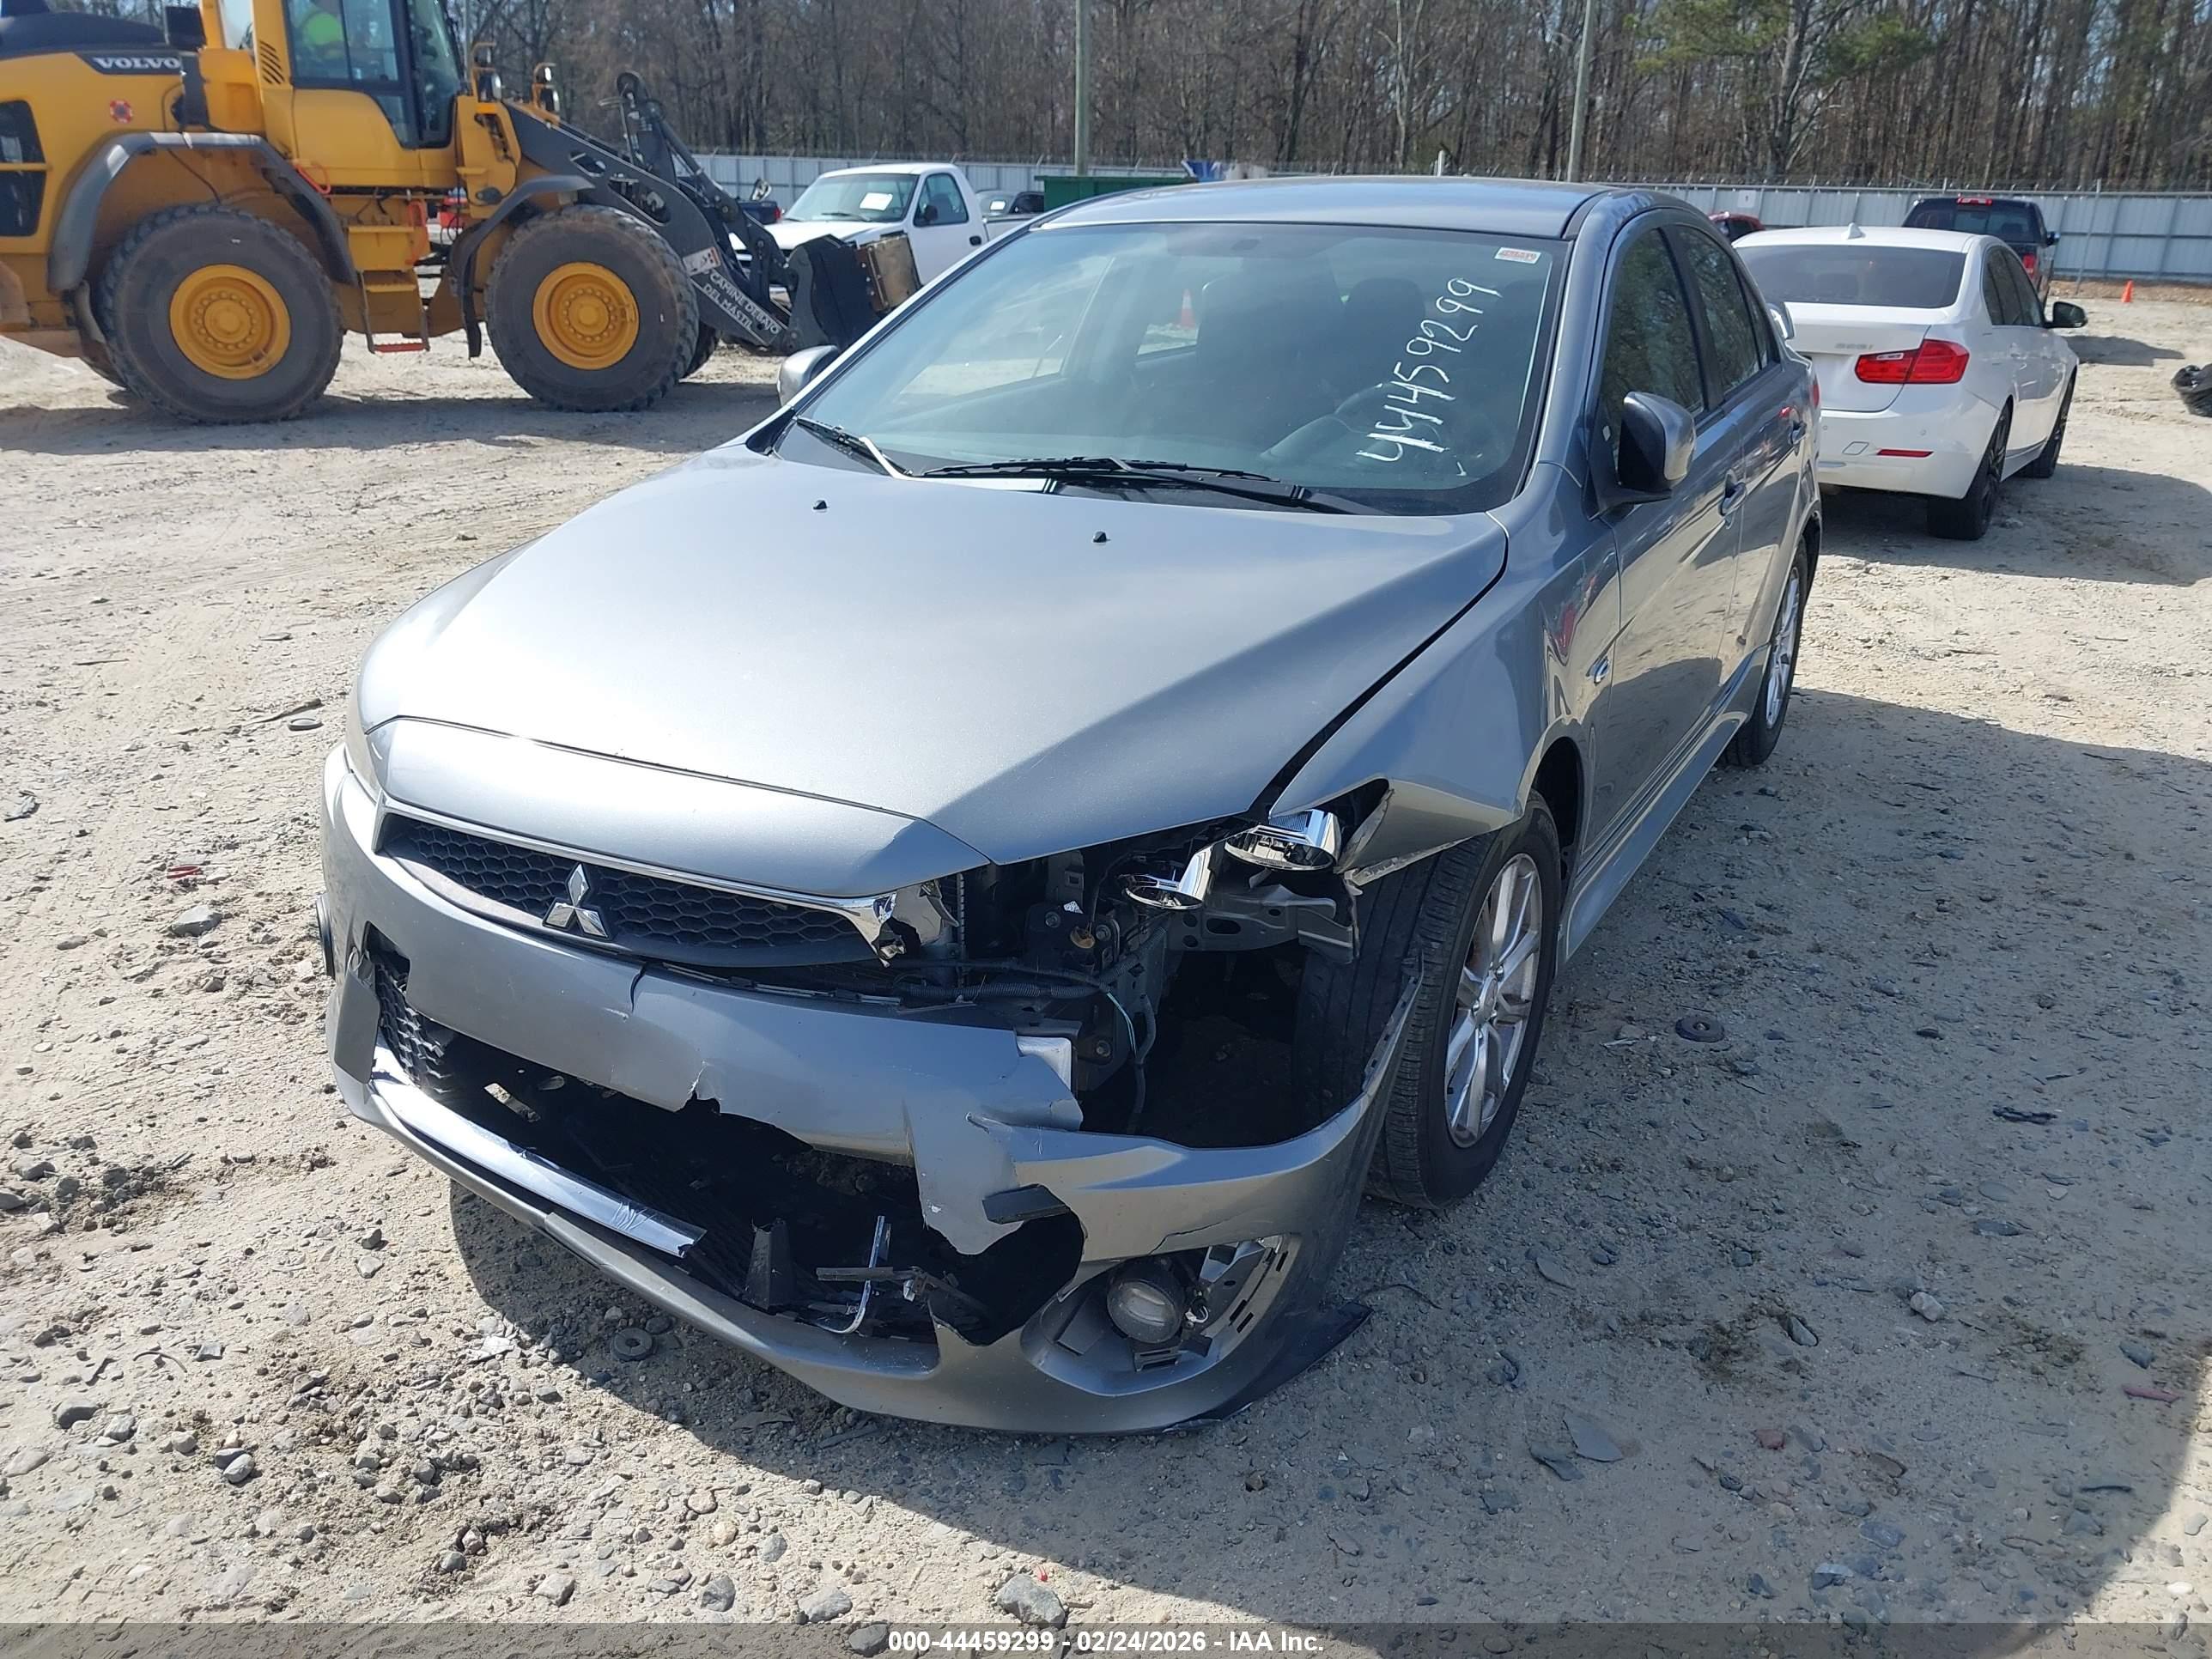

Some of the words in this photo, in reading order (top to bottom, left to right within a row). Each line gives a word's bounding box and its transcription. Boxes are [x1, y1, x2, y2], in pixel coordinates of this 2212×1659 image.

[92, 57, 181, 69] VOLVO
[703, 283, 721, 304] DEL
[710, 271, 747, 308] CAMINE
[744, 301, 781, 335] DEBAJO
[1355, 277, 1503, 462] 44459299
